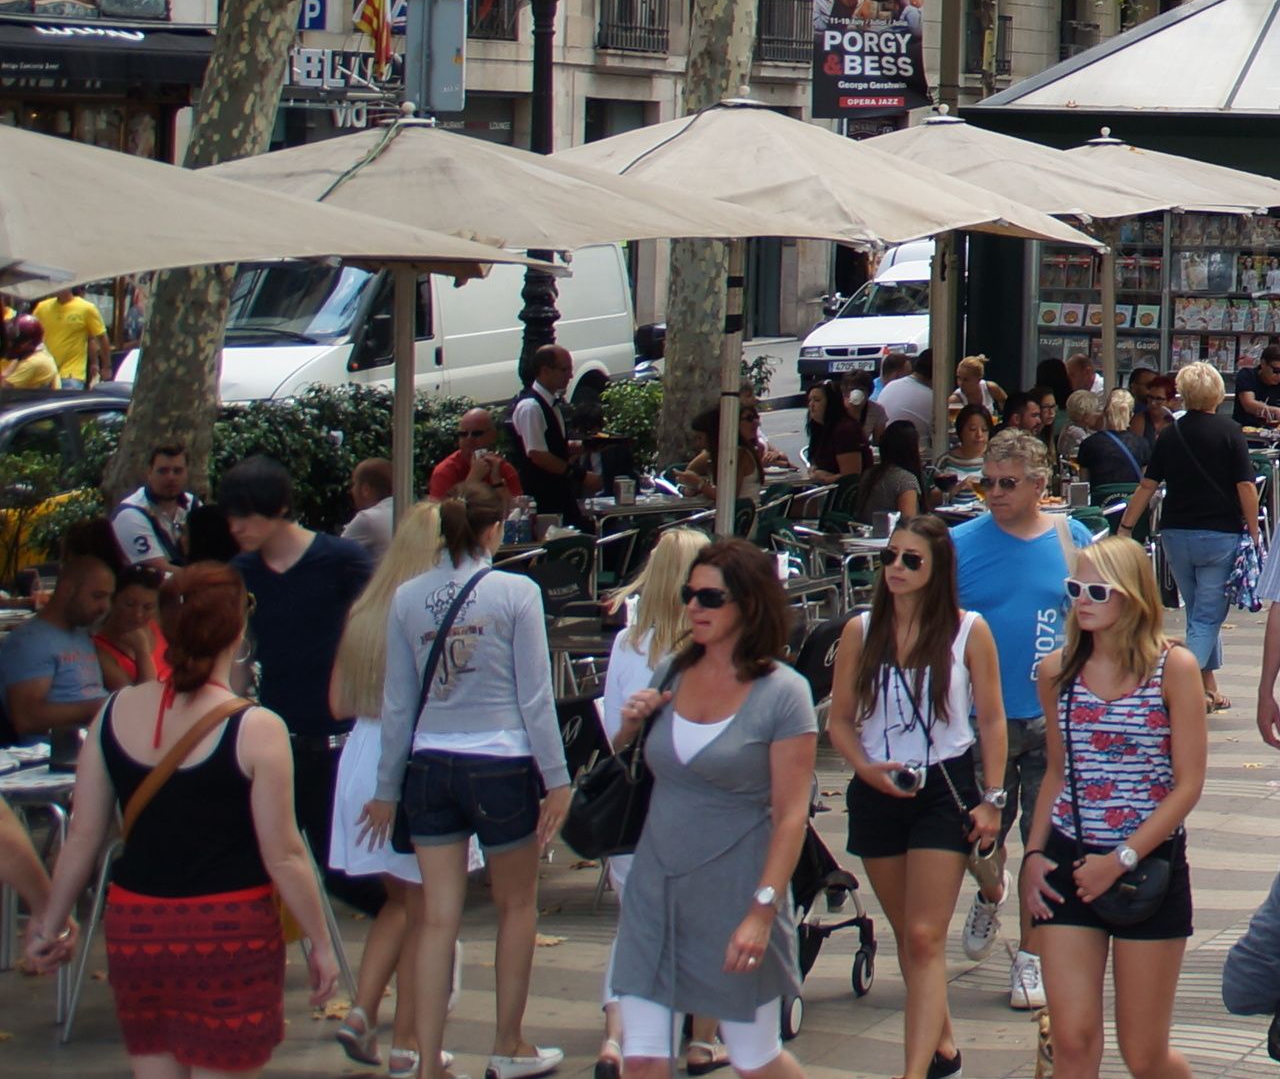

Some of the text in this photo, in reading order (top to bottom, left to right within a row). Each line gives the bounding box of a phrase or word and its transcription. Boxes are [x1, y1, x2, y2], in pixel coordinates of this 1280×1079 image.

[823, 30, 912, 54] PORGY
[838, 81, 868, 90] George
[133, 535, 150, 553] 3
